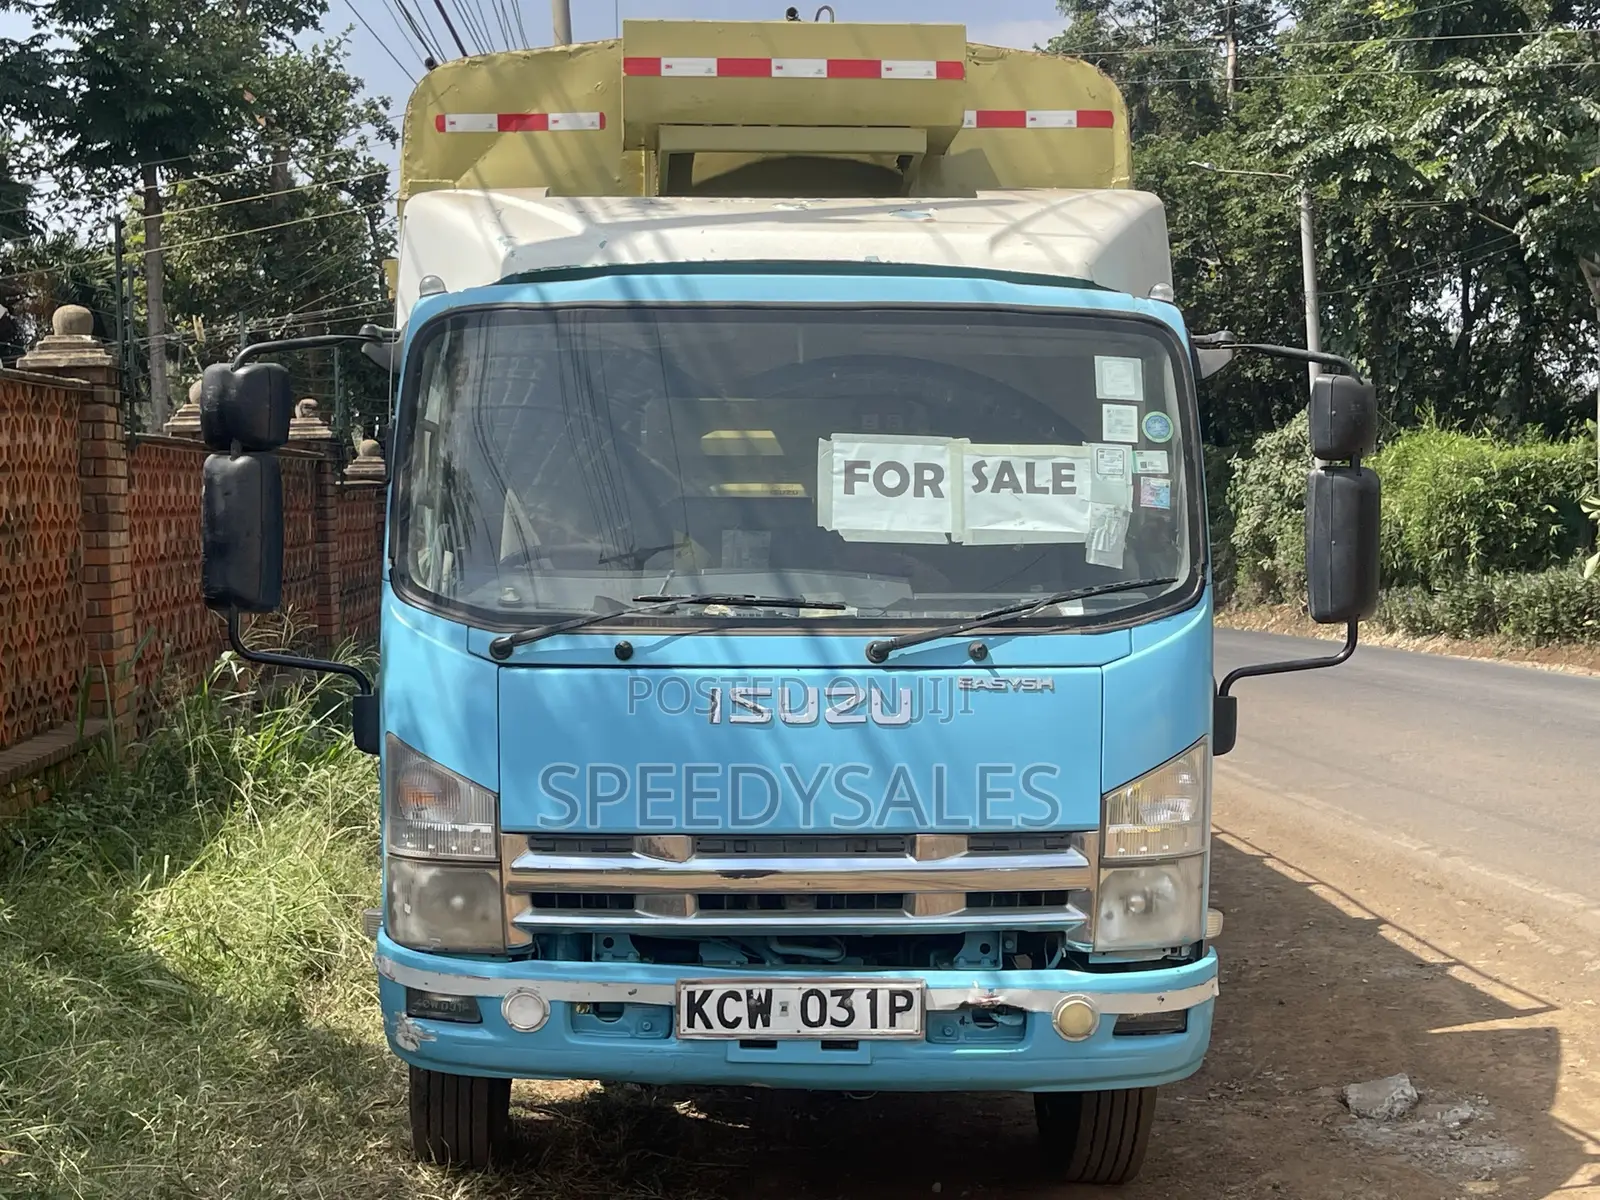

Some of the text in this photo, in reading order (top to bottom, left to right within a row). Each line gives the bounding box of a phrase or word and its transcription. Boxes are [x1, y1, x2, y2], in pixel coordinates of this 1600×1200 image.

[844, 460, 945, 498] FOR
[971, 459, 1077, 495] SALE
[709, 687, 912, 724] ISUZU
[686, 988, 914, 1029] KCW 031P
